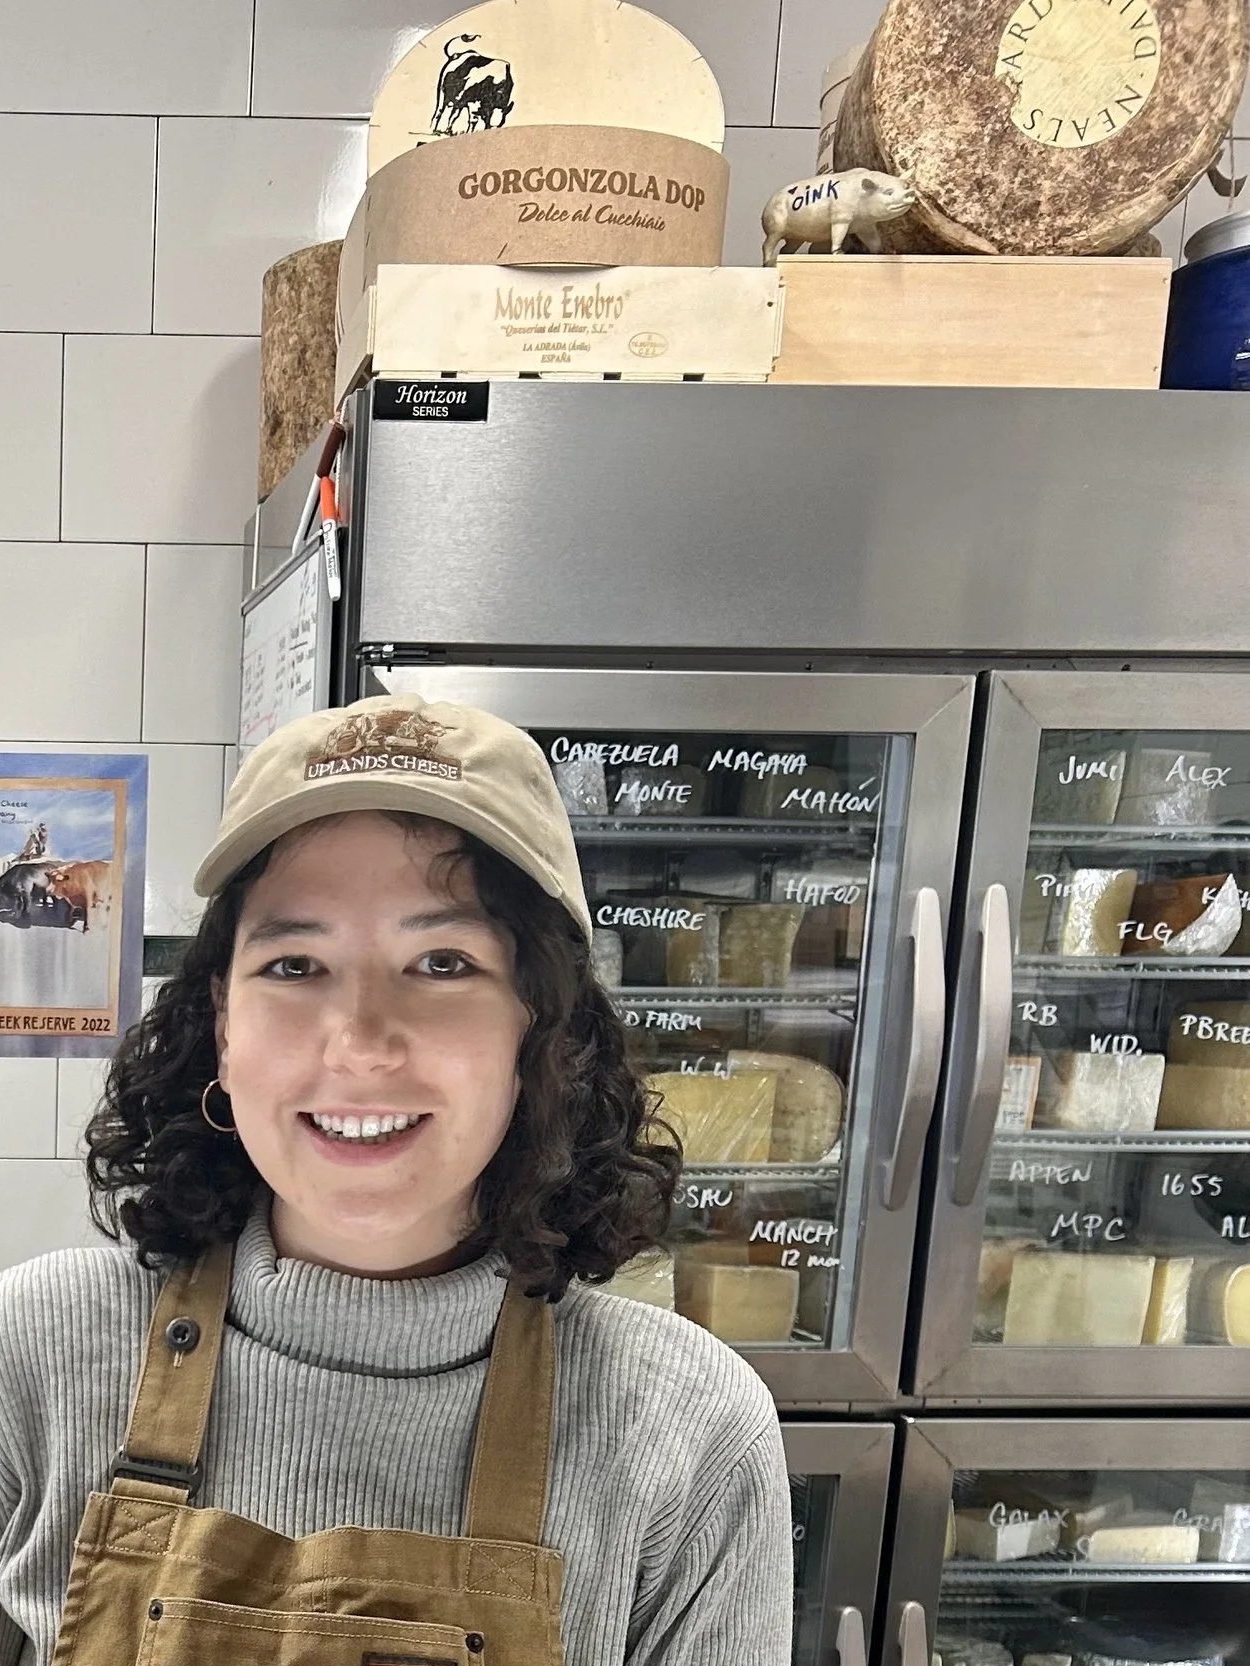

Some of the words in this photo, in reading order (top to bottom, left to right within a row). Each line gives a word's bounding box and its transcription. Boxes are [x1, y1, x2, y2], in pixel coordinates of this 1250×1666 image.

[458, 167, 660, 200] GORGONZOLA
[665, 179, 705, 212] DOP
[518, 202, 571, 223] Dolce
[572, 204, 592, 222] al
[595, 204, 666, 232] Cucchiaio
[494, 286, 552, 321] Monte
[548, 323, 560, 333] del
[523, 343, 533, 351] LA
[395, 386, 467, 405] Horizon
[412, 406, 449, 418] SERIES
[551, 737, 679, 766] CABEZUELA
[308, 754, 388, 779] UPLANDS
[391, 754, 459, 780] CHEESE
[0, 800, 28, 808] Cheese
[615, 780, 692, 804] MONTE
[784, 879, 861, 906] HAFOD
[596, 905, 707, 931] CHESHIRE
[23, 1015, 76, 1031] RESERVE
[82, 1017, 111, 1032] 2022
[750, 1220, 838, 1246] MANCH
[781, 1249, 800, 1267] 12
